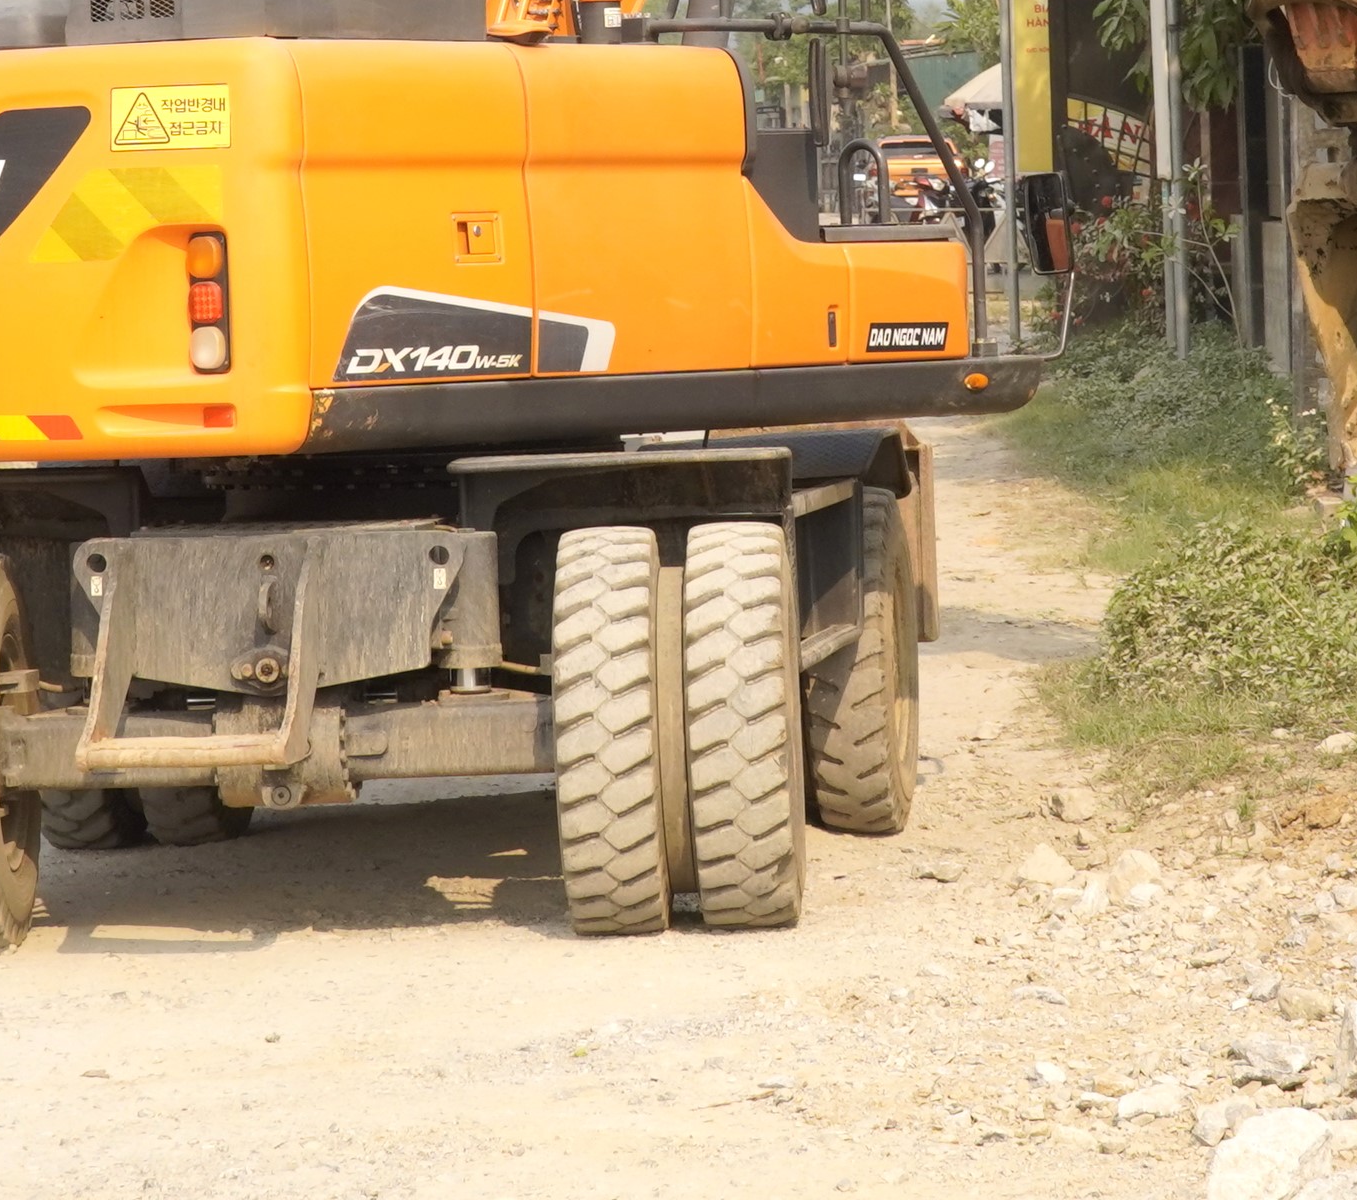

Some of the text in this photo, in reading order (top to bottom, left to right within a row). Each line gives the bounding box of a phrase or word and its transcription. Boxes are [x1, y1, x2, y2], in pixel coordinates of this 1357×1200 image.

[161, 96, 226, 114] 작업반경내
[169, 119, 222, 137] 접근금지
[869, 327, 946, 347] DAO NGOC NAM
